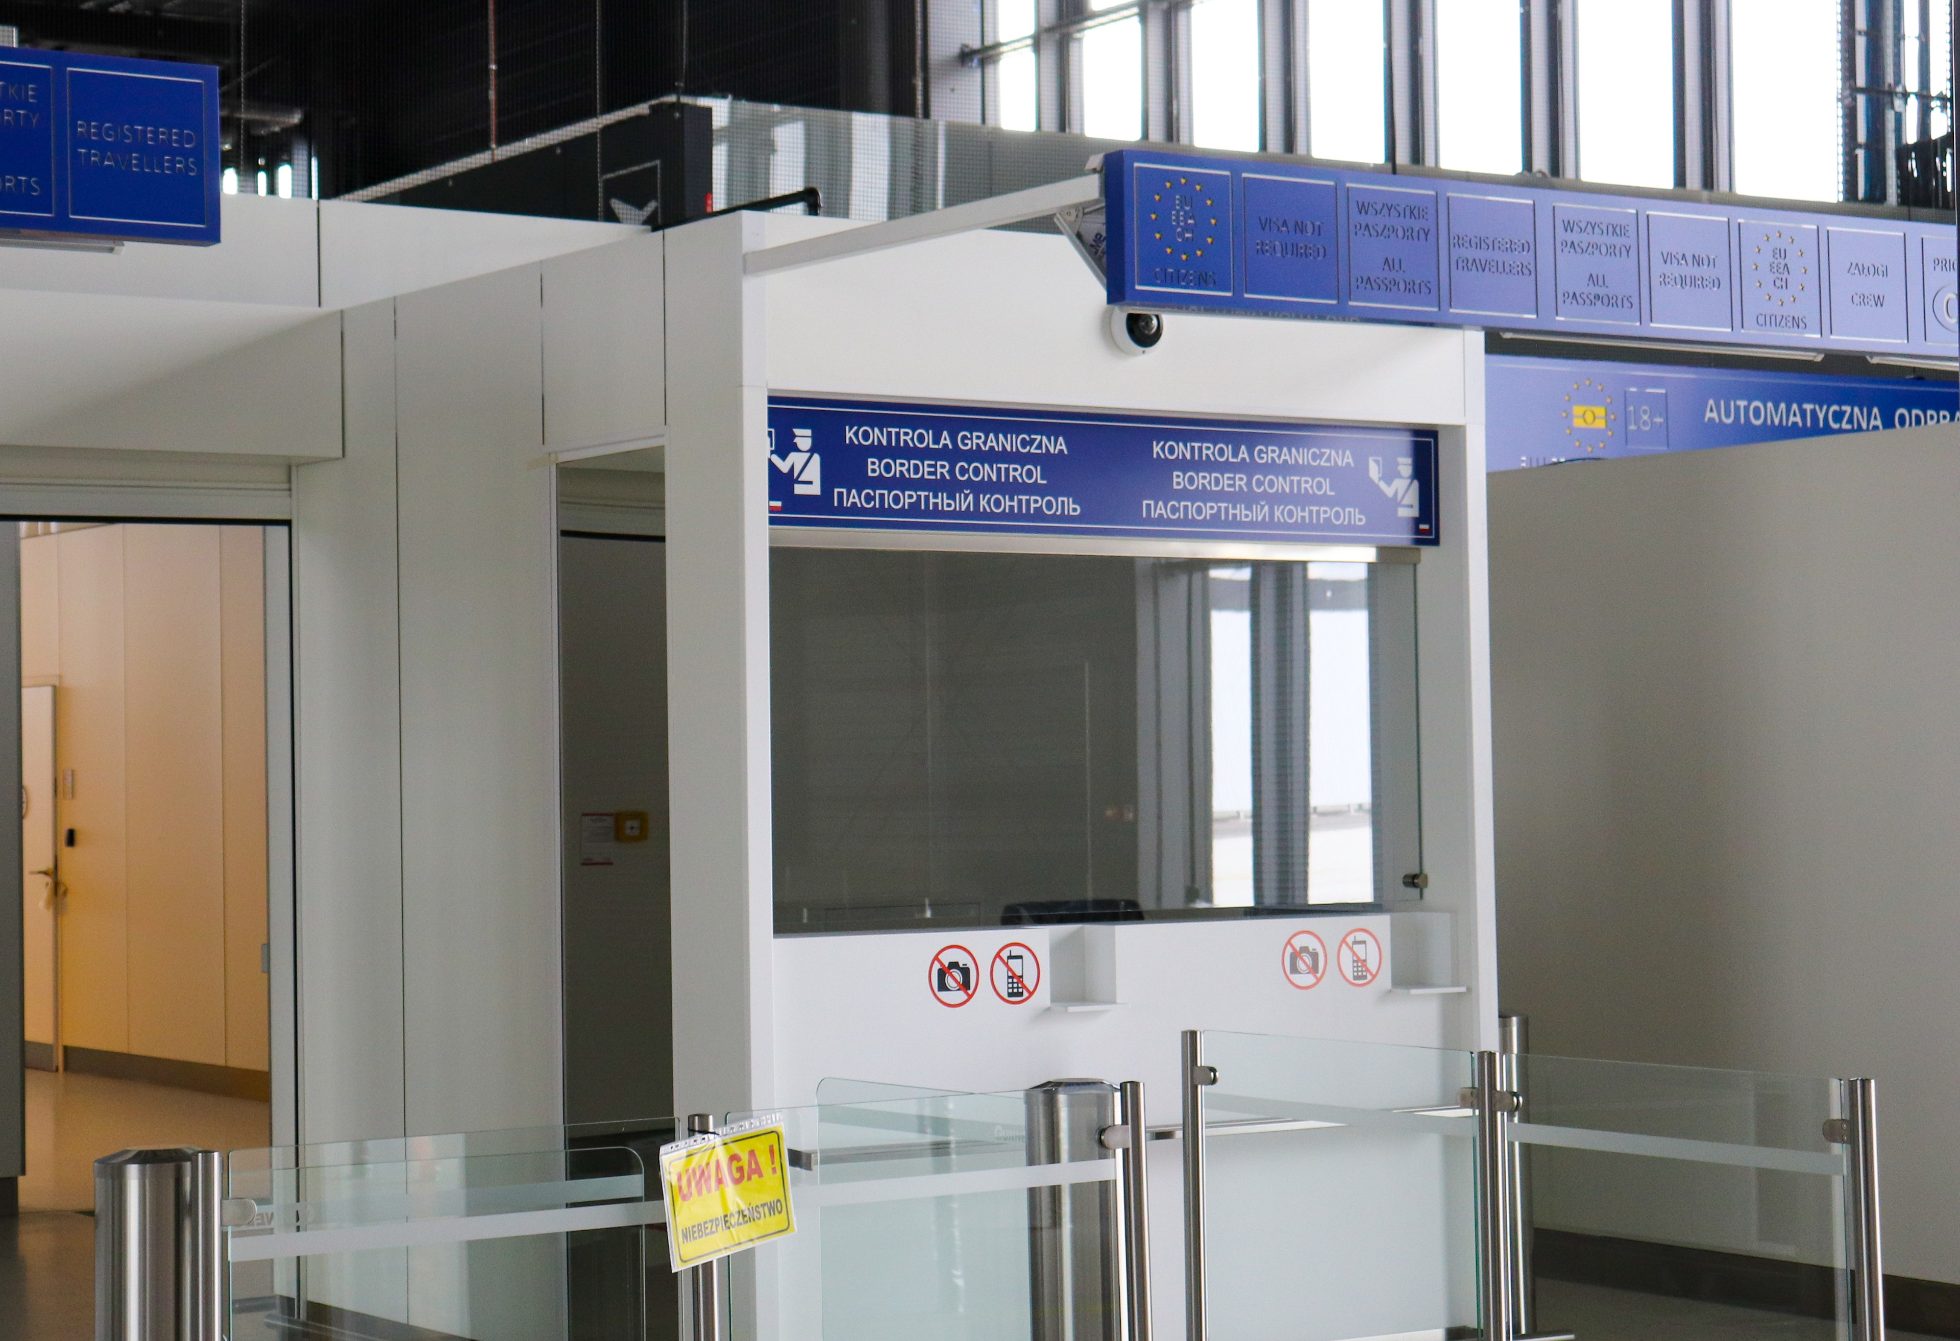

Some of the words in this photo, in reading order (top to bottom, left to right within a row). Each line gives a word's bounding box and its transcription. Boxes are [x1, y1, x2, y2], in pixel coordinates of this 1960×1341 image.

[77, 120, 196, 148] REGISTERED
[77, 149, 198, 176] TRAVELLERS
[1176, 195, 1193, 210] EU
[1356, 200, 1429, 221] WSZYSTKIE
[1172, 211, 1195, 226] EEA
[1258, 216, 1290, 234] VISA
[1294, 220, 1324, 236] NOT
[1176, 227, 1194, 242] CH
[1355, 223, 1431, 242] PASZPORTY
[1562, 219, 1631, 238] WSZYSTKIE
[1256, 240, 1327, 260] REQUIRED
[1453, 234, 1531, 254] REGISTERED
[1560, 240, 1632, 259] PASZPORTY
[1661, 251, 1689, 267] VISA
[1692, 254, 1718, 270] NOT
[1772, 248, 1787, 260] EU
[1382, 256, 1406, 273] ALL
[1455, 257, 1532, 277] TRAVELLERS
[1769, 262, 1790, 276] EEA
[1848, 262, 1889, 278] ZAŁOGI
[1154, 268, 1216, 287] CITIZENS
[1356, 276, 1432, 295] PASSPORTS
[1587, 273, 1609, 288] ALL
[1659, 273, 1721, 290] REQUIRED
[1773, 277, 1788, 290] CH
[1562, 291, 1634, 309] PASSPORTS
[1851, 292, 1885, 308] CREW
[1756, 313, 1807, 330] CITIZENS
[1626, 405, 1664, 431] 18+
[1704, 399, 1884, 430] AUTOMATYCZNA
[845, 425, 952, 449] KONTROLA
[957, 431, 1068, 454] GRANICZNA
[1152, 440, 1250, 463] KONTROLA
[1253, 445, 1355, 468] GRANICZNA
[867, 458, 950, 480] BORDER
[955, 461, 1047, 484] CONTROL
[1172, 471, 1248, 492] BORDER
[1252, 474, 1335, 496] CONTROL
[834, 488, 974, 512] ПАСПОРТНЫЙ
[979, 493, 1081, 516] КОНТРОЛЬ
[1142, 500, 1269, 522] ПАСПОРТНЫЙ
[1274, 504, 1366, 526] КОНТРОЛЬ
[676, 1149, 764, 1202] UWAGA
[681, 1199, 784, 1245] NIEBEZPIECZEŃSTWO
